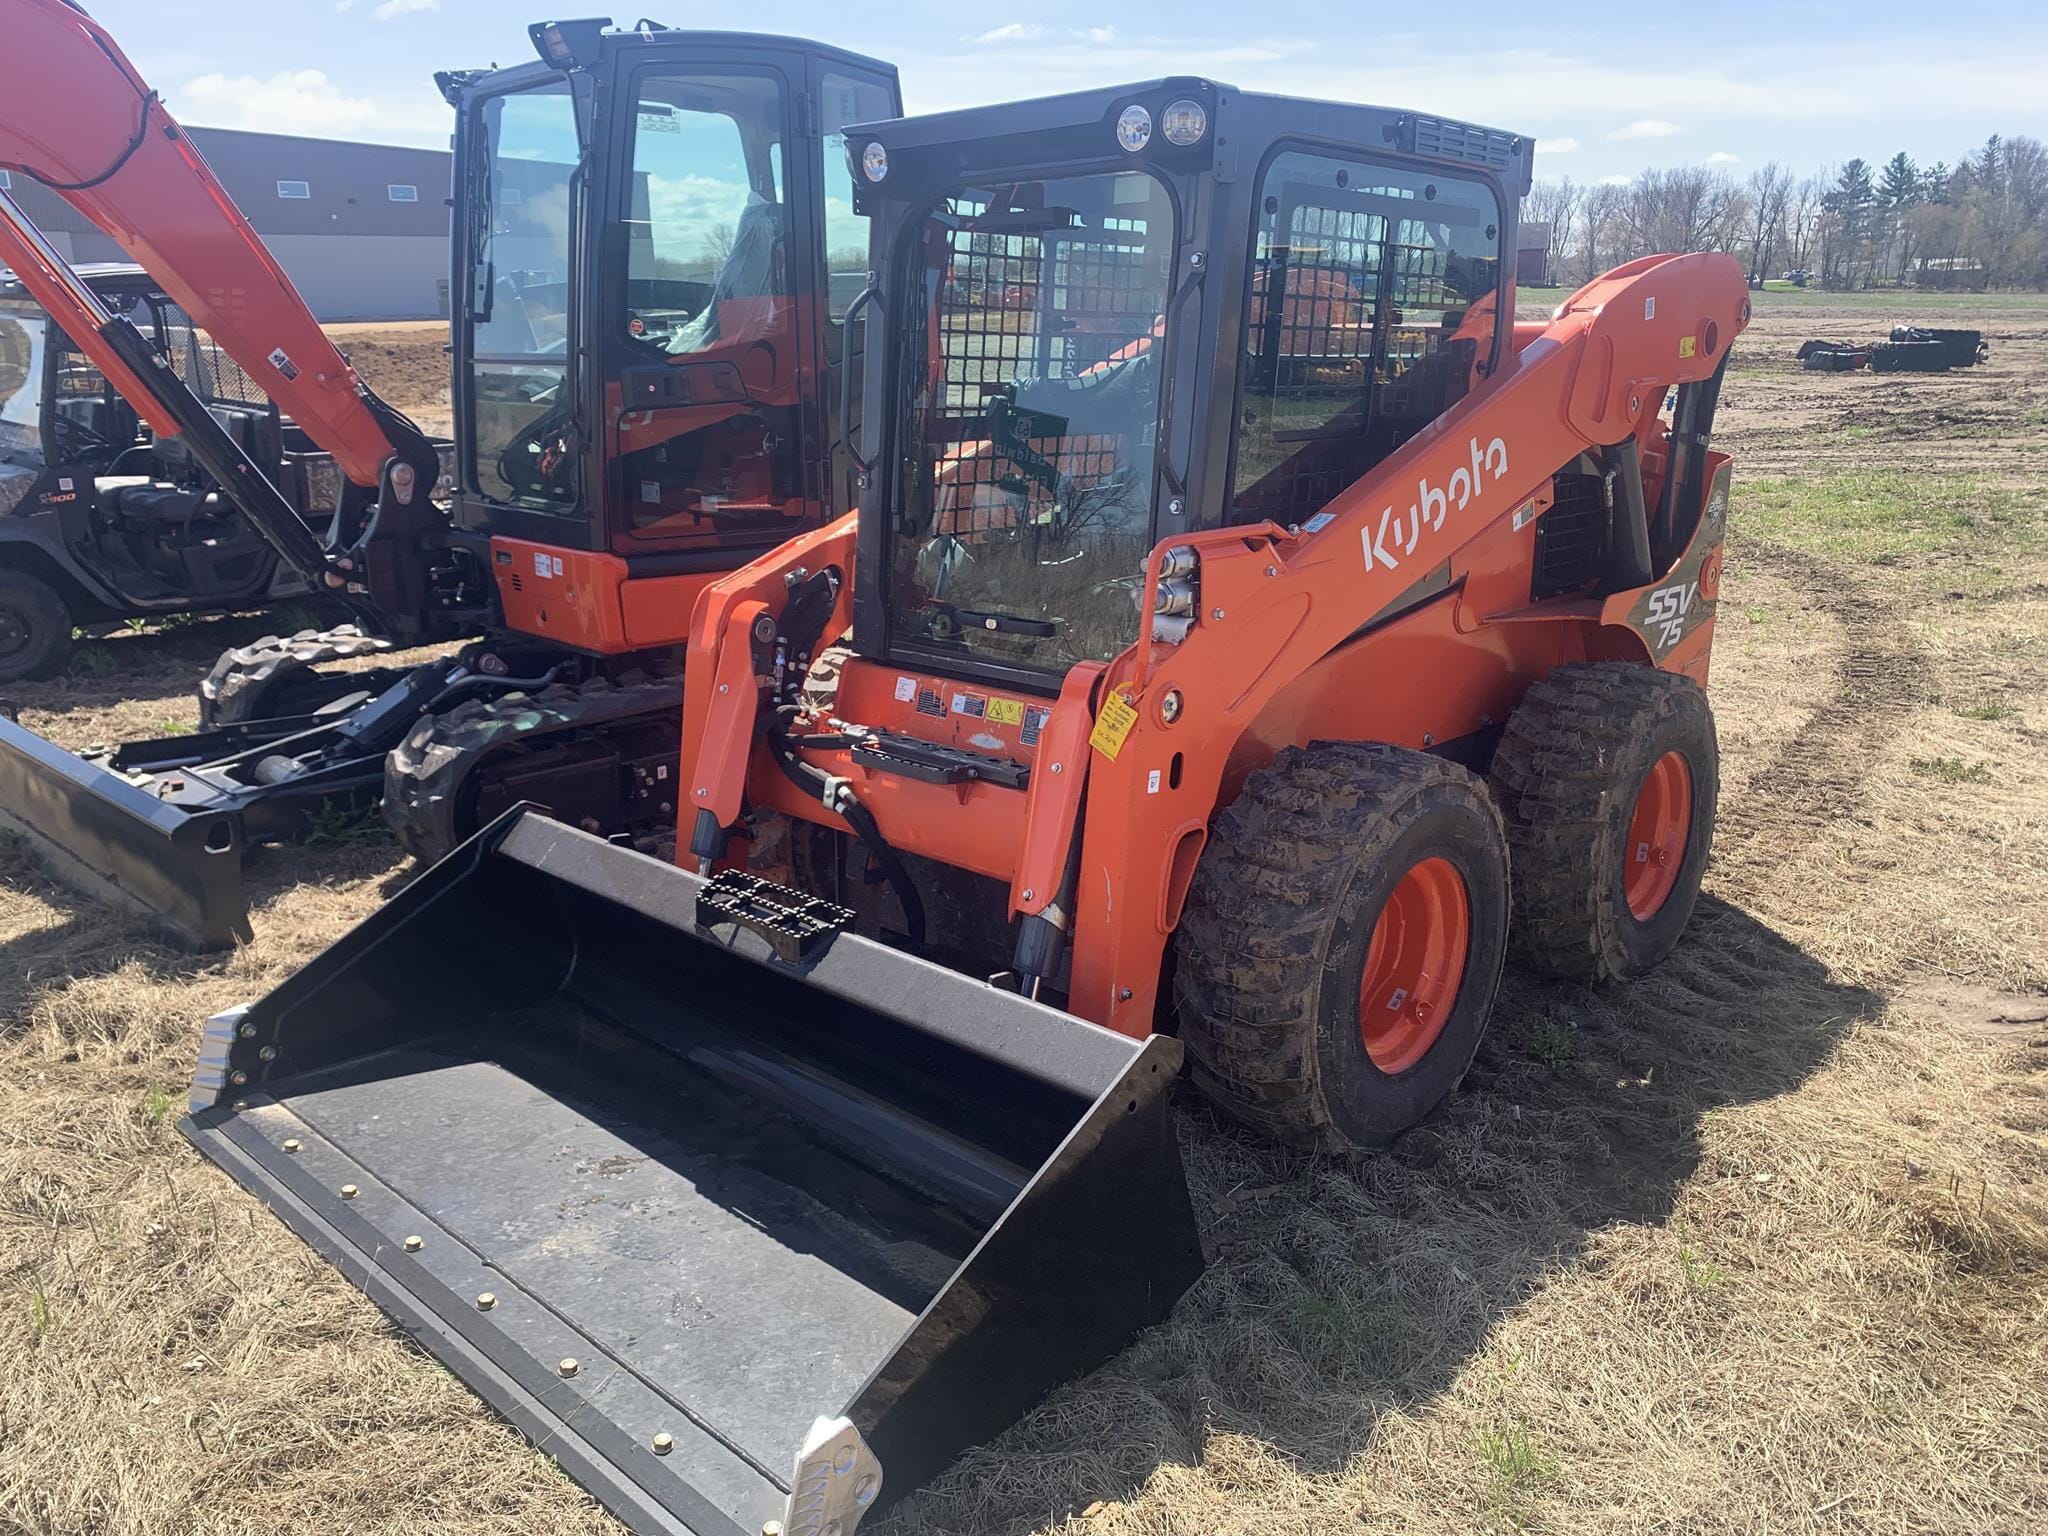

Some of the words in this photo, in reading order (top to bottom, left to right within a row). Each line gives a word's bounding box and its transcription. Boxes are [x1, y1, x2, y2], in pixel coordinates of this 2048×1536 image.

[1361, 437, 1508, 573] Kubota
[1643, 581, 1698, 625] SSV
[1656, 617, 1684, 649] 75
